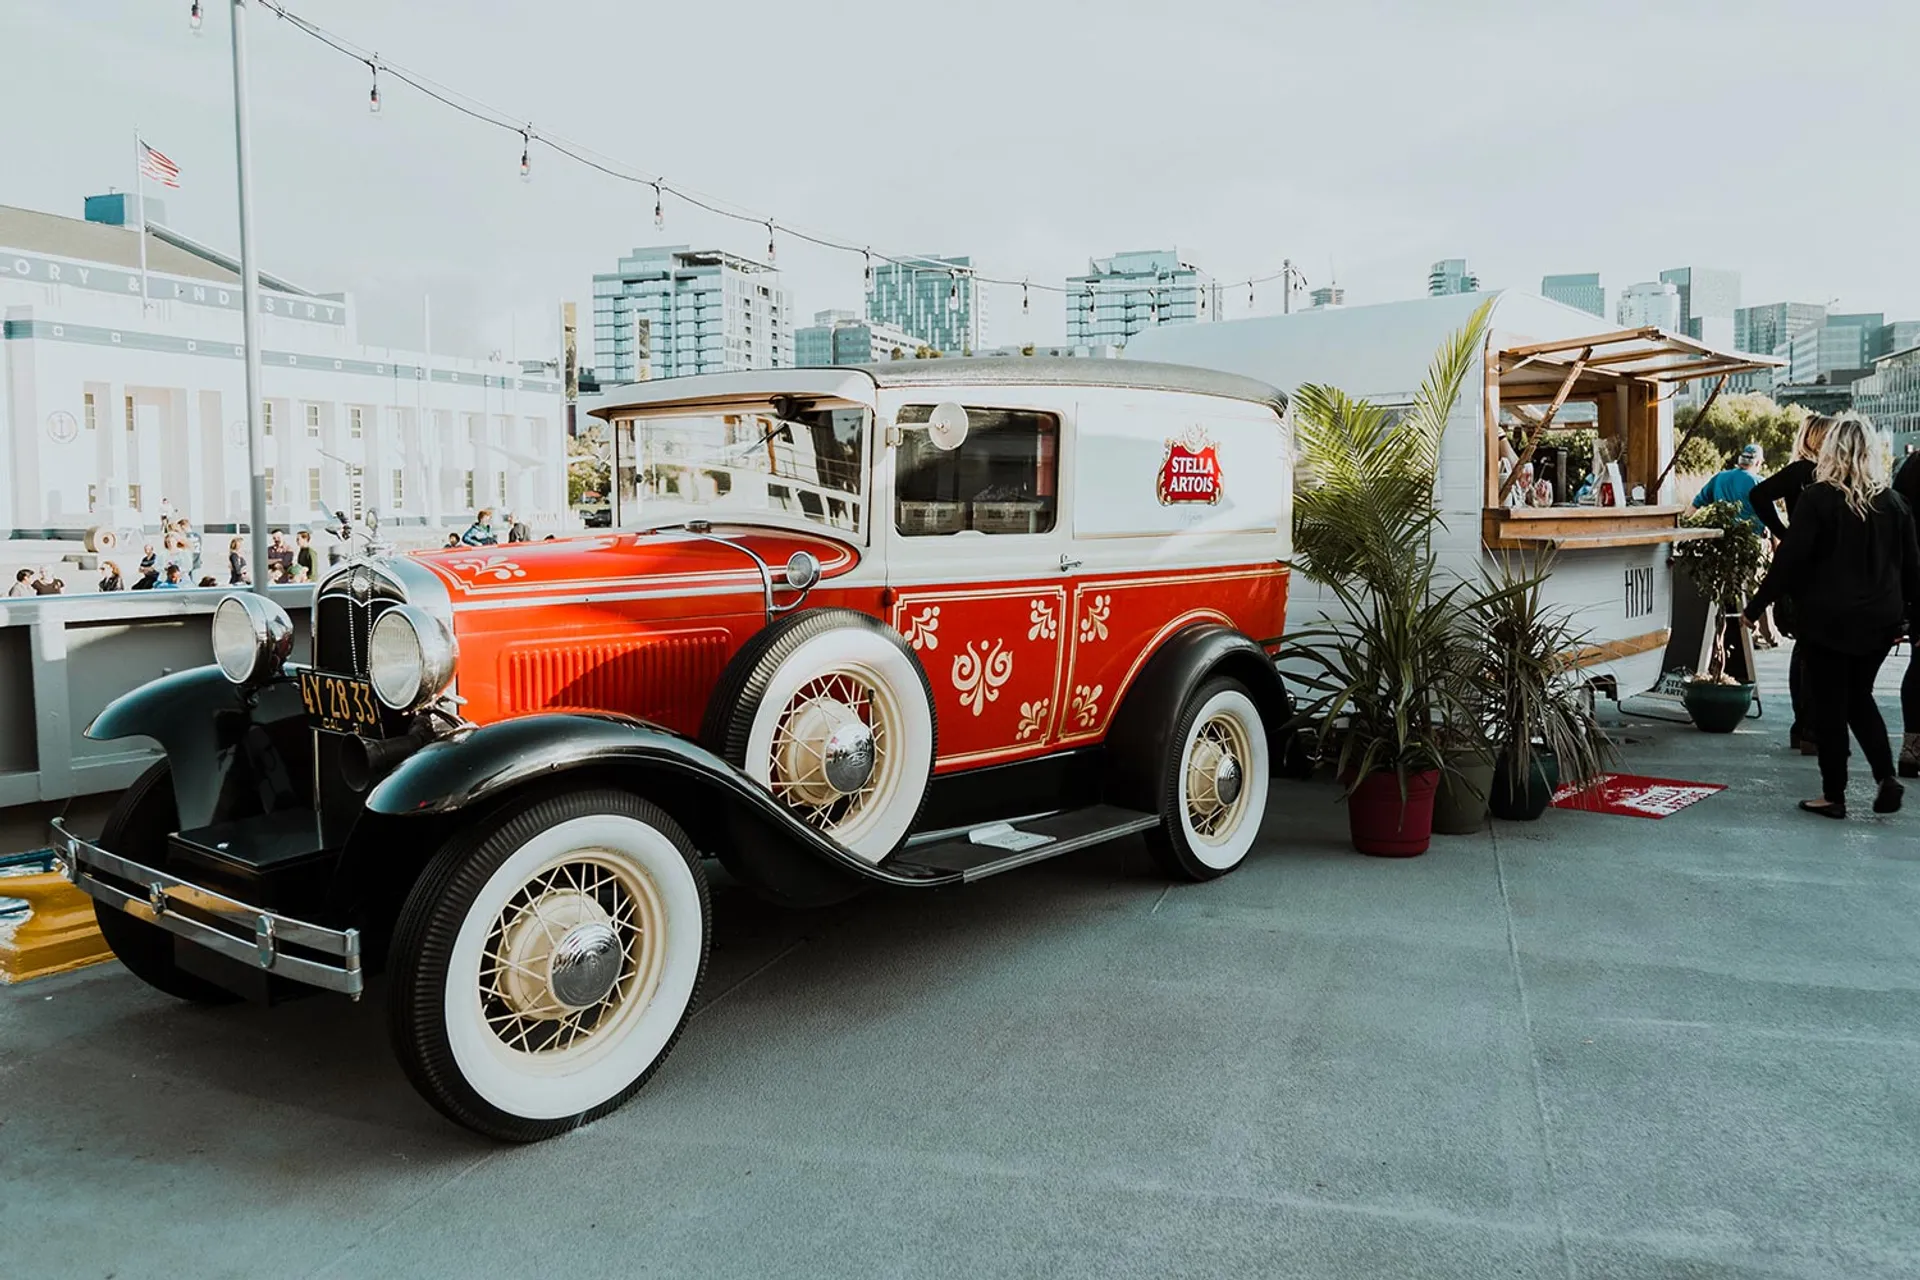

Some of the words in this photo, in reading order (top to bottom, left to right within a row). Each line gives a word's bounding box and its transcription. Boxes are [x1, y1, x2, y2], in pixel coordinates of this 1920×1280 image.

[0, 258, 90, 284] ORY
[127, 276, 141, 292] &
[173, 282, 338, 321] INDSTRY
[1171, 456, 1215, 474] STELLA
[1169, 475, 1214, 493] ARTOIS
[301, 673, 324, 716] 4Y
[326, 677, 351, 720] 28
[350, 681, 376, 725] 33
